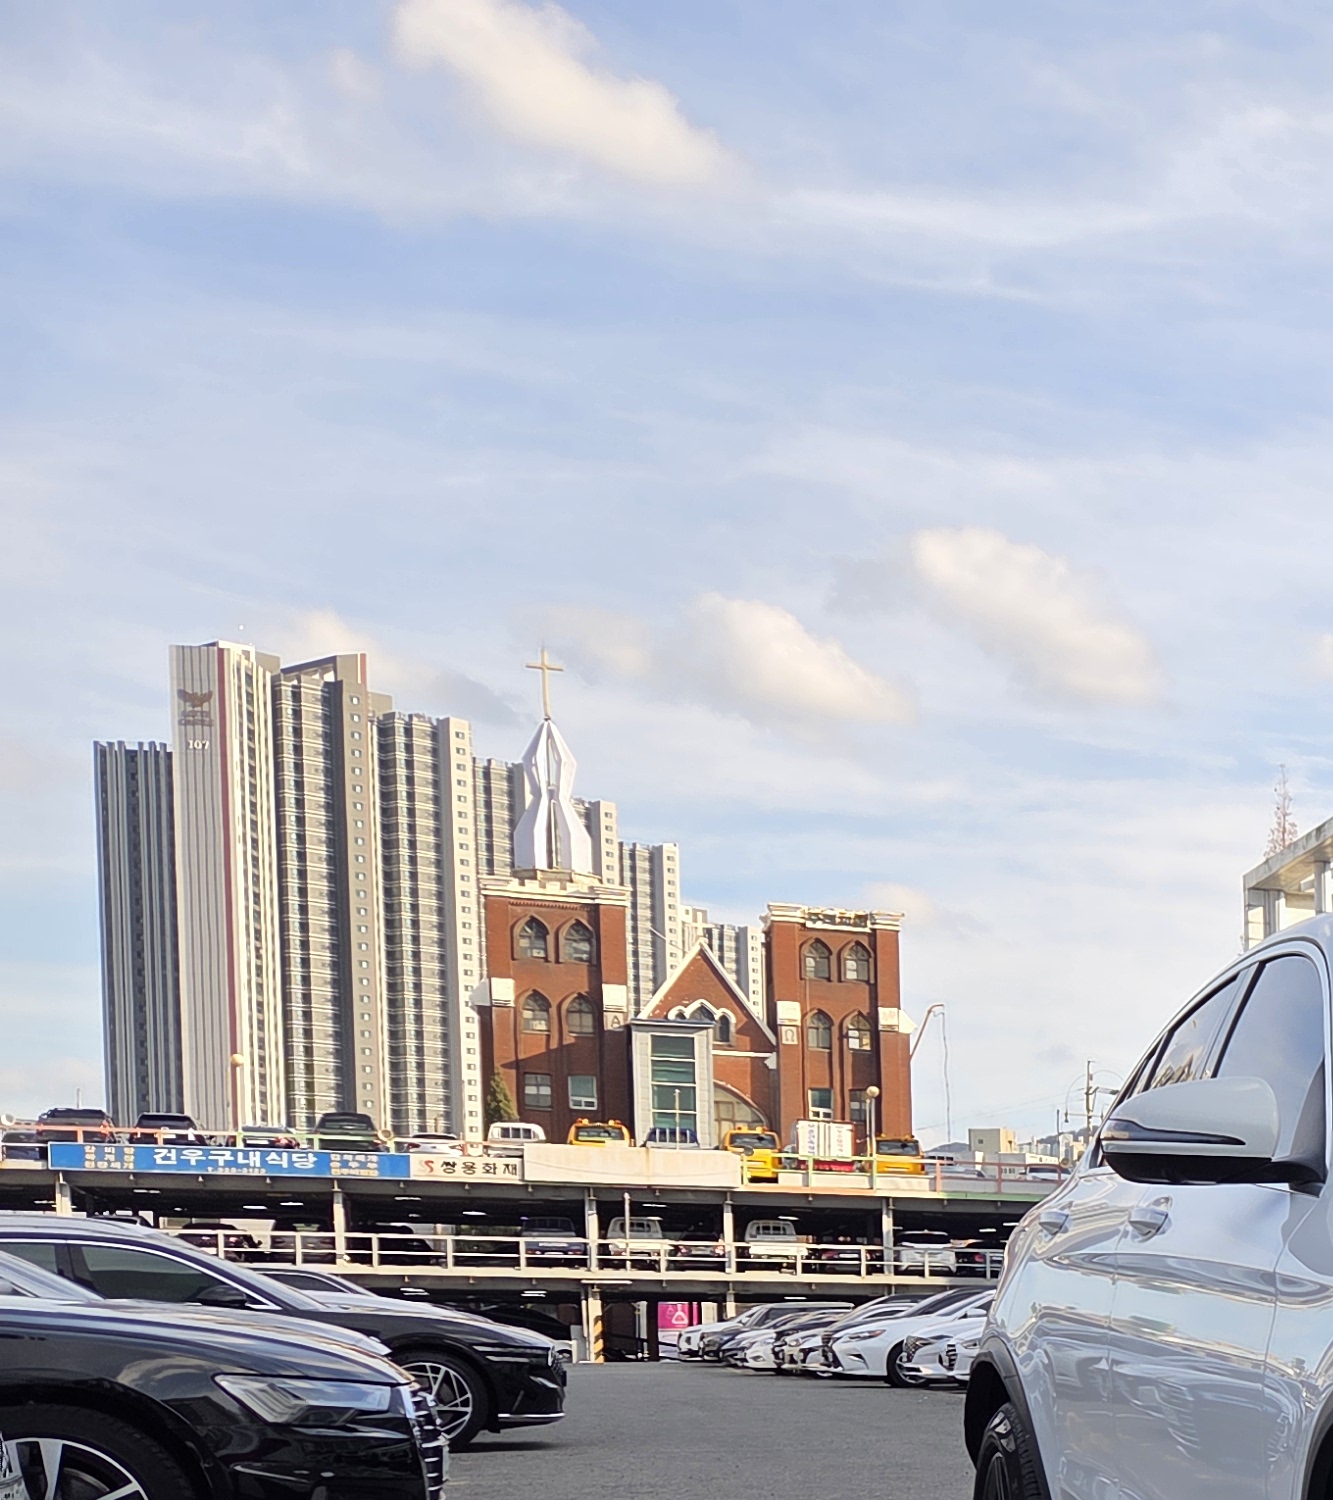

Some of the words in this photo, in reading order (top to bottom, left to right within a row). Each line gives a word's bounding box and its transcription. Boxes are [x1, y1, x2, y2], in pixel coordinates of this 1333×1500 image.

[188, 739, 210, 750] 107
[153, 1148, 318, 1169] 건우구내식당
[440, 1160, 518, 1176] 쌍용화재
